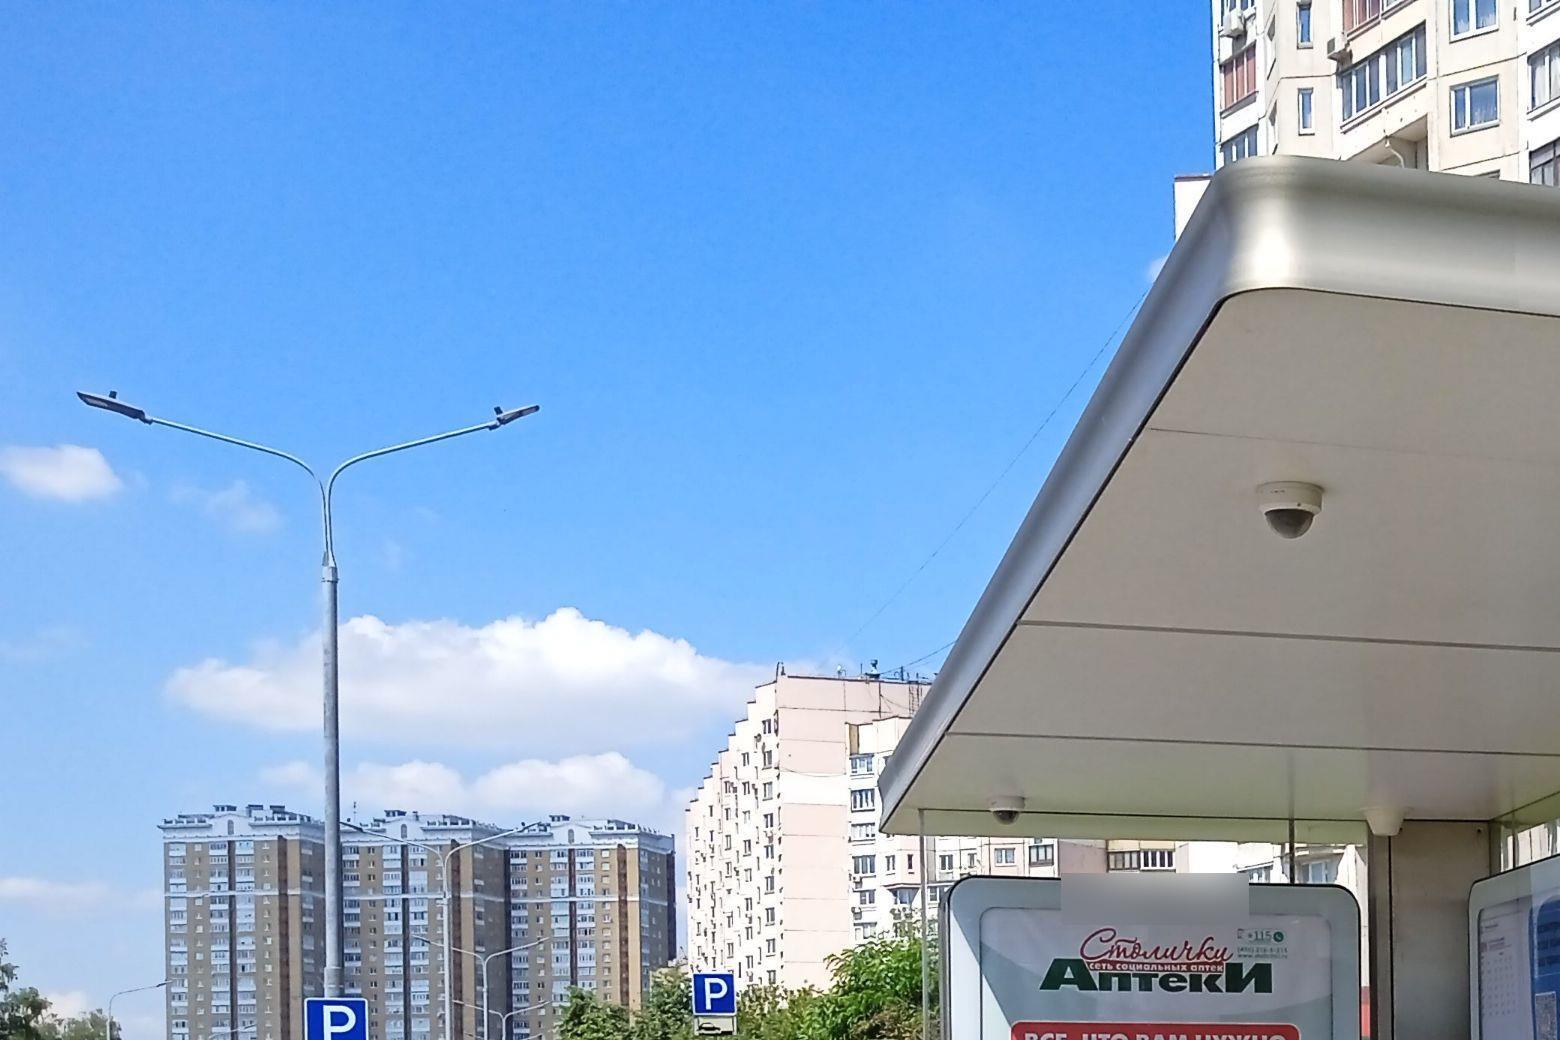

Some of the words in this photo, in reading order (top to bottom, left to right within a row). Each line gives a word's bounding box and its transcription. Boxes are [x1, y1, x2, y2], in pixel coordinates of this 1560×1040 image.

[1079, 927, 1234, 962] Столички
[1089, 962, 1114, 970] сеть
[1116, 963, 1187, 972] социальных
[1190, 964, 1223, 972] аптек
[704, 977, 728, 1010] P
